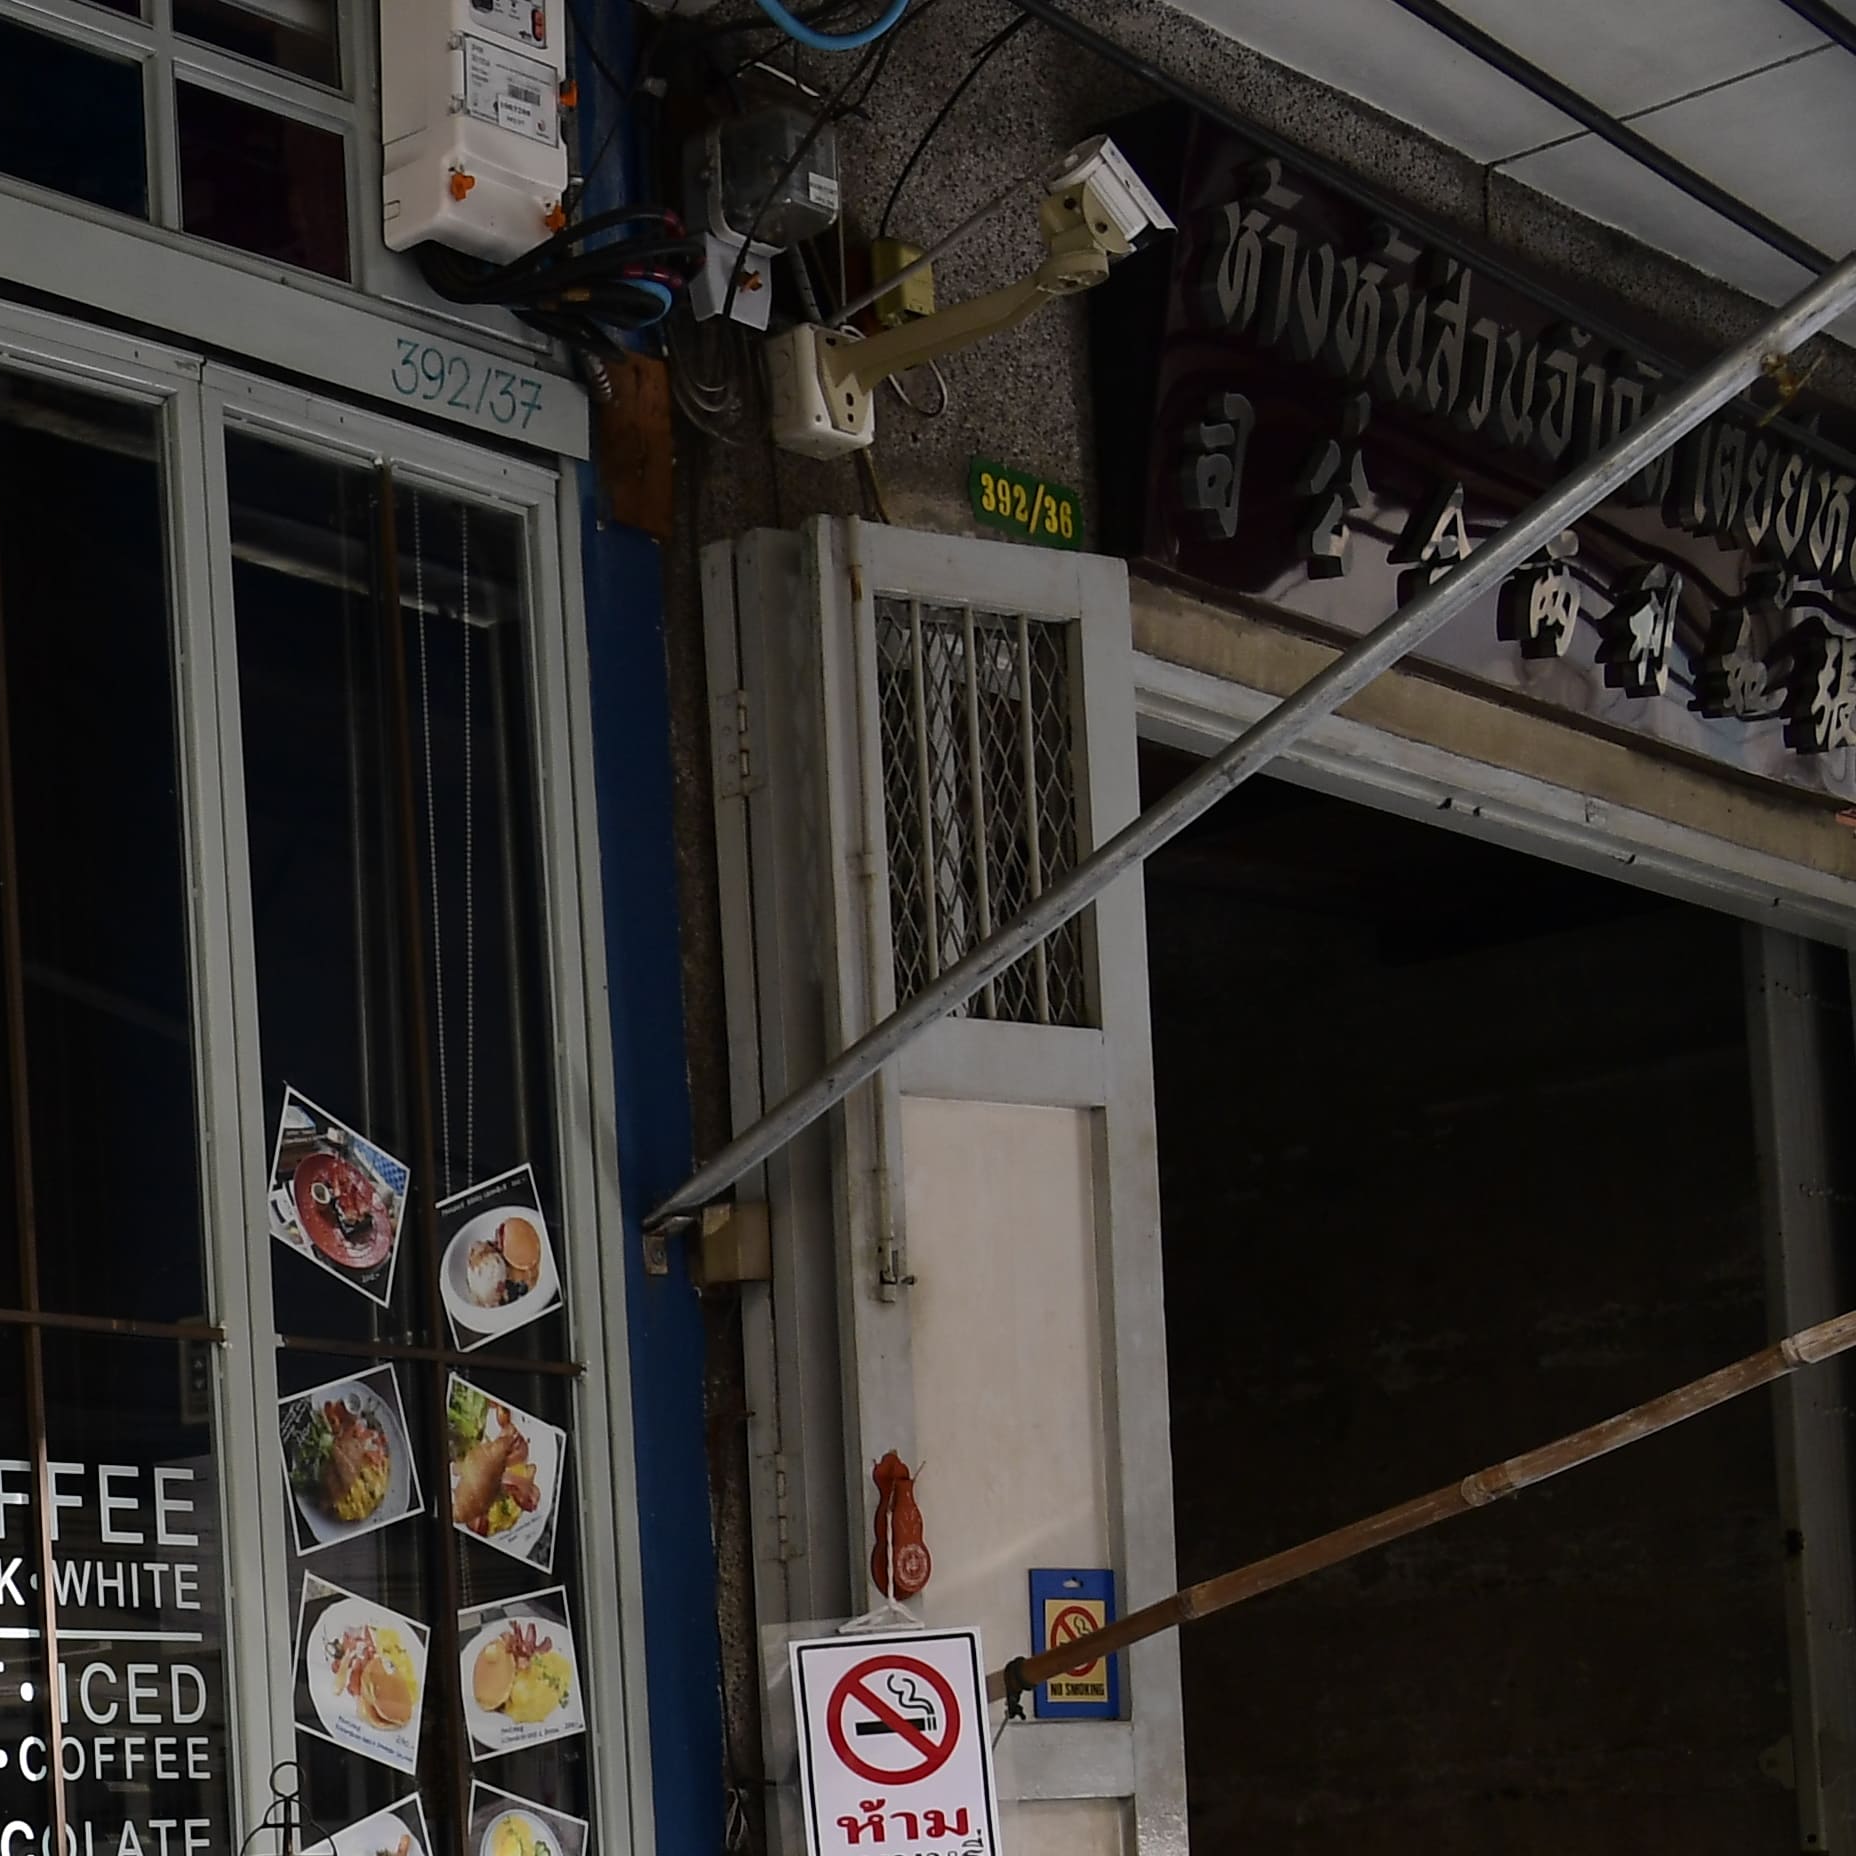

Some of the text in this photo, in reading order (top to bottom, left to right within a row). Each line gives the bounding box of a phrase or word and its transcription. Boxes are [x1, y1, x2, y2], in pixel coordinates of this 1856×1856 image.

[391, 337, 543, 431] 392/37
[980, 471, 1073, 541] 392/36
[51, 1560, 202, 1611] WHITE
[58, 1661, 208, 1726] ICED
[1050, 1683, 1105, 1696] NO SMOKING
[18, 1734, 212, 1784] COFFEE
[836, 1797, 971, 1846] ห้าม
